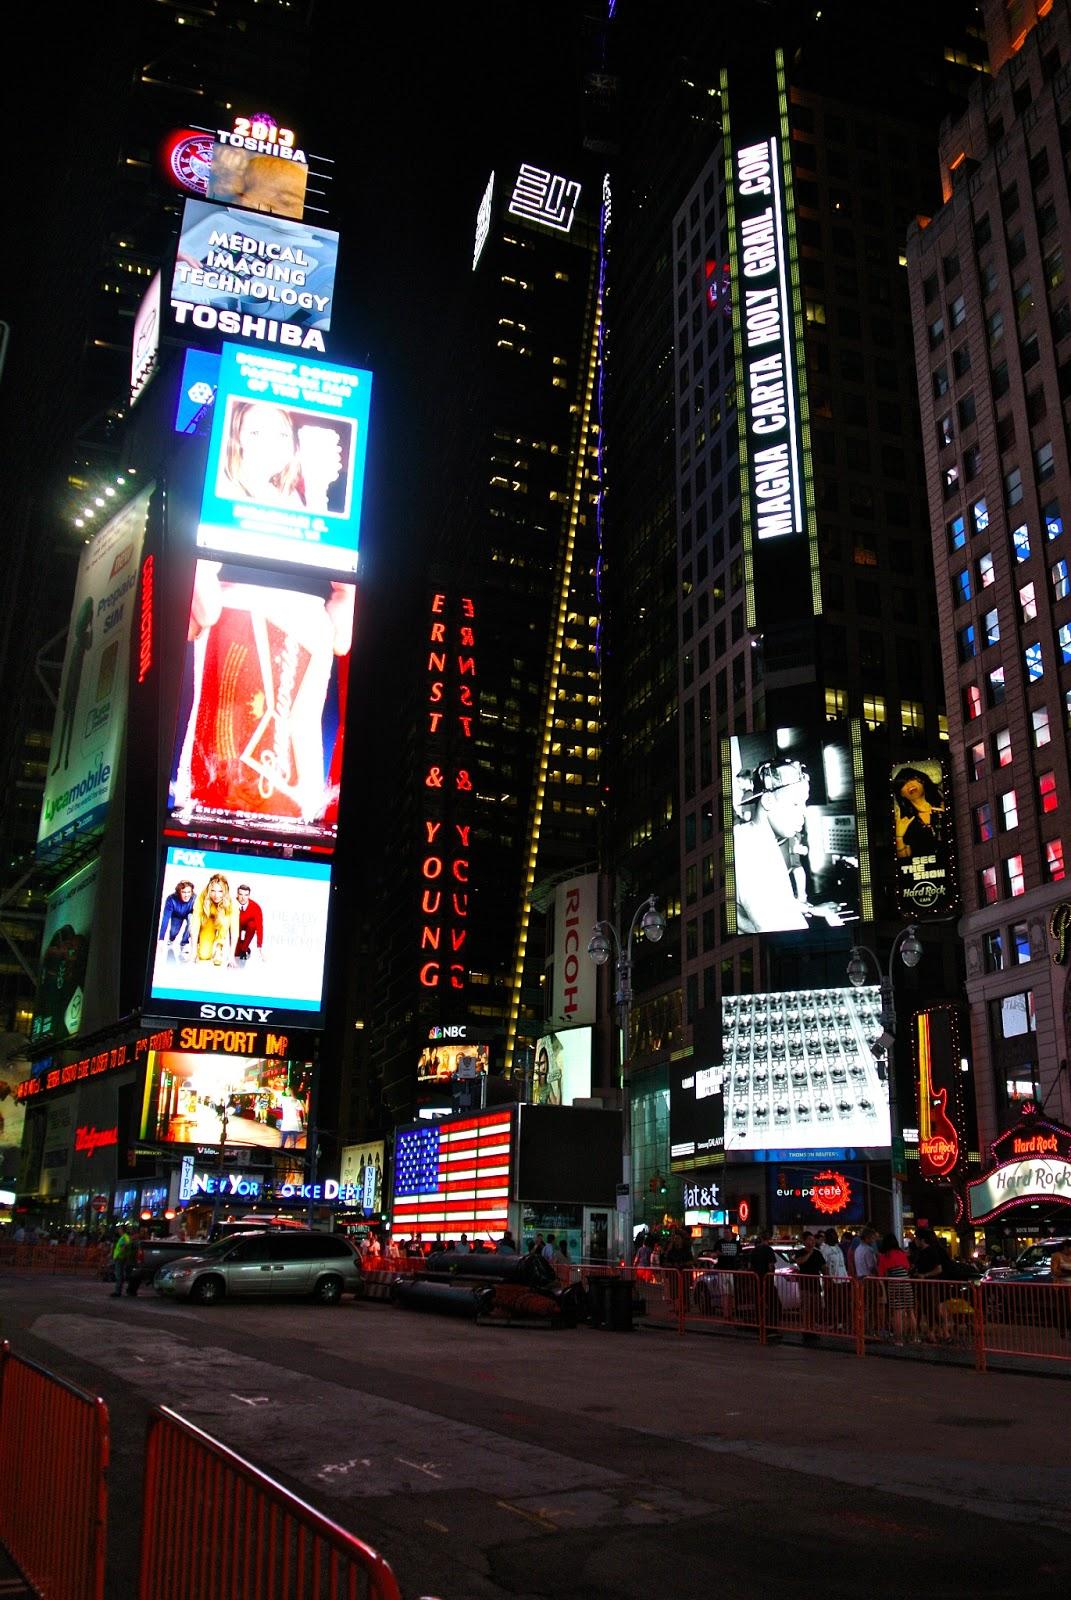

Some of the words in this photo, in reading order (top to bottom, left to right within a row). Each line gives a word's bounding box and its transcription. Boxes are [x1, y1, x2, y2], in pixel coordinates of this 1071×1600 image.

[216, 129, 307, 163] TOSHIBA
[234, 117, 295, 147] 2013
[208, 230, 309, 266] MEDICAL
[741, 206, 777, 278] GRAIL
[206, 251, 307, 286] IMAGING
[177, 264, 329, 312] TECHNOLOGY
[170, 300, 326, 352] TOSHIBA
[745, 287, 781, 347] HOLY
[750, 353, 787, 435] CARTA
[754, 443, 793, 539] MAGNA
[98, 569, 137, 616] Prepaid
[104, 603, 125, 634] SIM
[428, 594, 446, 733] ERNST
[44, 761, 111, 822] Lycamobile
[425, 767, 443, 788] &
[901, 864, 925, 874] THE
[912, 855, 936, 865] SEE
[913, 869, 945, 880] SHOW
[420, 821, 443, 987] YOUNG
[903, 887, 924, 898] Hard
[925, 885, 946, 896] Rock
[564, 888, 580, 1015] RICOH
[200, 1004, 273, 1023] SONY
[179, 1027, 258, 1054] SUPPORT
[443, 1025, 467, 1038] NBC
[921, 1142, 938, 1154] Hard
[939, 1141, 955, 1155] Rock
[1014, 1136, 1036, 1153] Hard
[1036, 1133, 1058, 1153] Rock
[229, 1174, 260, 1196] YOR
[366, 1167, 374, 1206] NYPD
[776, 1187, 815, 1197] europa
[996, 1169, 1032, 1189] Hard
[1034, 1165, 1071, 1189] Rock
[687, 1183, 720, 1207] at&t
